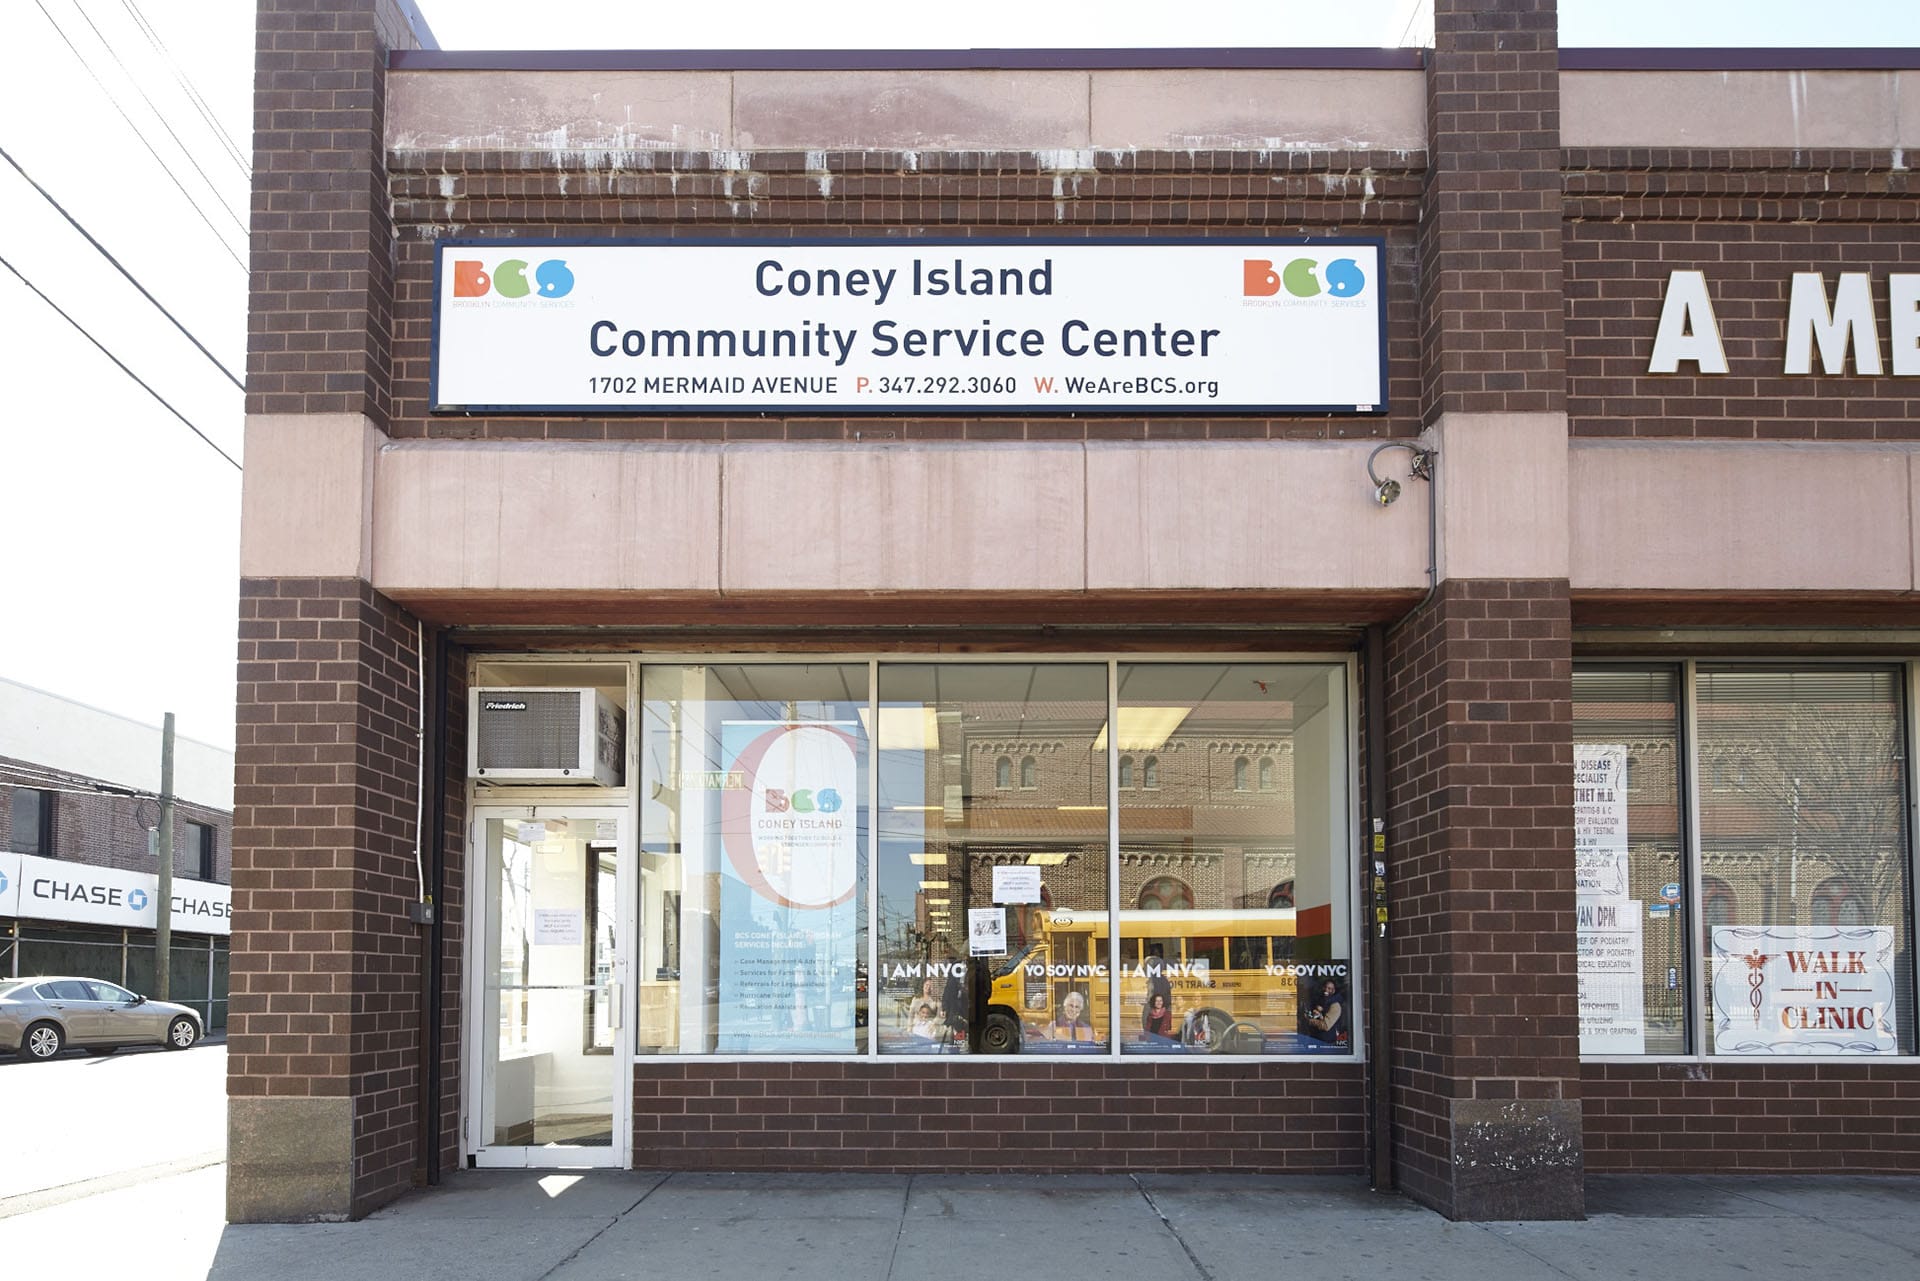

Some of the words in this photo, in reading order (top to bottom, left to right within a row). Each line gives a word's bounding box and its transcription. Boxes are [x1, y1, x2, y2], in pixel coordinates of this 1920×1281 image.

[454, 259, 575, 298] BCS
[756, 259, 896, 305] Coney
[913, 259, 1052, 296] Island
[1243, 258, 1365, 298] BCS
[1242, 300, 1281, 308] BROOKLYN
[1648, 270, 1730, 374] A
[590, 320, 857, 366] Community
[872, 320, 1044, 357] Service
[1062, 320, 1220, 357] Center
[589, 377, 636, 393] 1702
[644, 377, 745, 393] MERMAID
[751, 377, 838, 393] AVENUE
[856, 377, 873, 393] P.
[879, 377, 1017, 393] 347.292.3060
[1034, 377, 1058, 393] W.
[1065, 377, 1219, 397] WeAreBCS.org
[486, 702, 525, 710] Friedrich
[1581, 760, 1611, 770] DISEASE
[765, 788, 843, 813] BCS
[758, 819, 796, 829] CONEY
[799, 819, 842, 829] ISLAND
[33, 878, 123, 907] CHASE
[1597, 905, 1616, 927] DPM
[883, 963, 888, 977] I
[892, 963, 921, 977] AM
[926, 963, 967, 978] NYC
[1024, 965, 1045, 976] YO
[1046, 965, 1076, 976] SOY
[1077, 965, 1106, 976] NYC
[1123, 963, 1128, 978] I
[1133, 963, 1161, 978] AM
[1166, 963, 1206, 978] NYC
[1265, 965, 1285, 976] YO
[1287, 965, 1316, 976] SOY
[1317, 965, 1347, 976] NYC
[1785, 951, 1868, 974] WALK
[1815, 981, 1839, 999] IN
[1782, 1006, 1875, 1030] CLINIC
